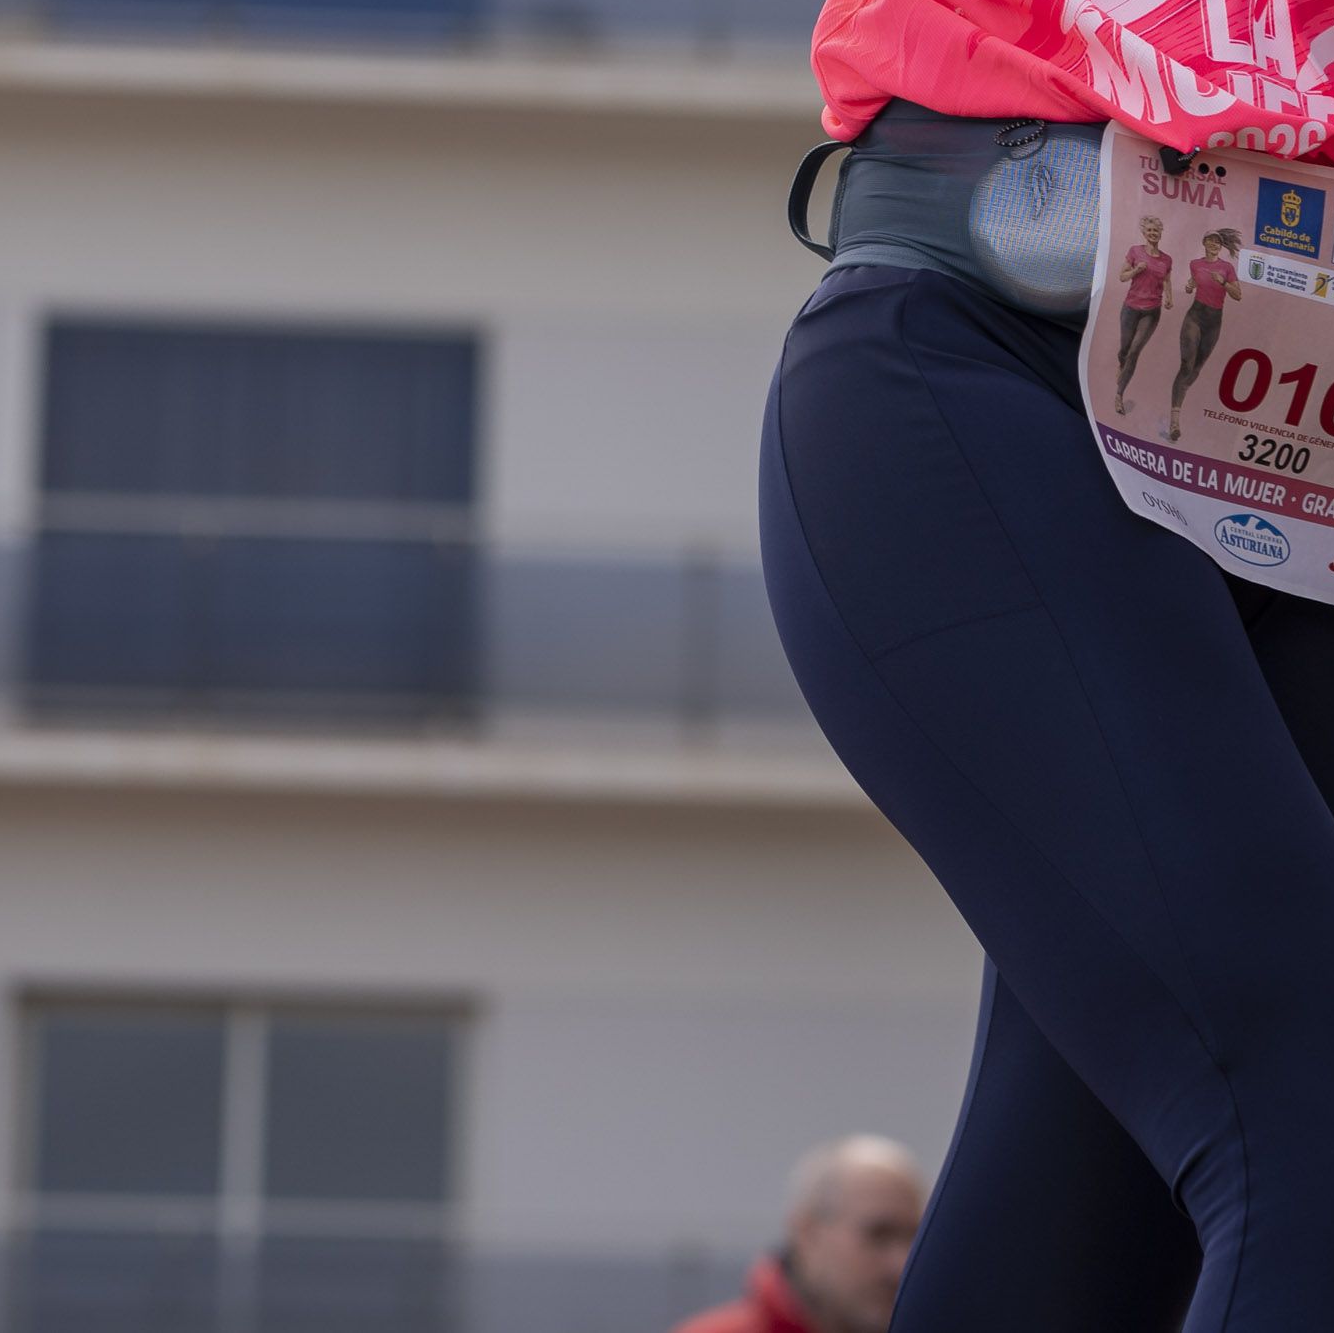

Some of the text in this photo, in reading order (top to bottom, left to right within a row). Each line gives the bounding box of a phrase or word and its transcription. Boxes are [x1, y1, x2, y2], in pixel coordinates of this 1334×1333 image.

[1139, 155, 1160, 171] TU
[1142, 172, 1226, 211] SUMA
[1259, 233, 1316, 253] Gran Canaria
[1264, 225, 1311, 243] Cabildo de
[1203, 408, 1249, 427] TELÉFONO
[1250, 421, 1296, 440] VIOLENCIA
[1297, 433, 1309, 443] DE
[1105, 434, 1168, 477] CARRERA
[1172, 459, 1194, 484] DE
[1197, 466, 1219, 491] LA
[1224, 473, 1287, 507] MUJER
[1238, 434, 1311, 474] 3200
[1220, 526, 1284, 560] ASTURIANA
